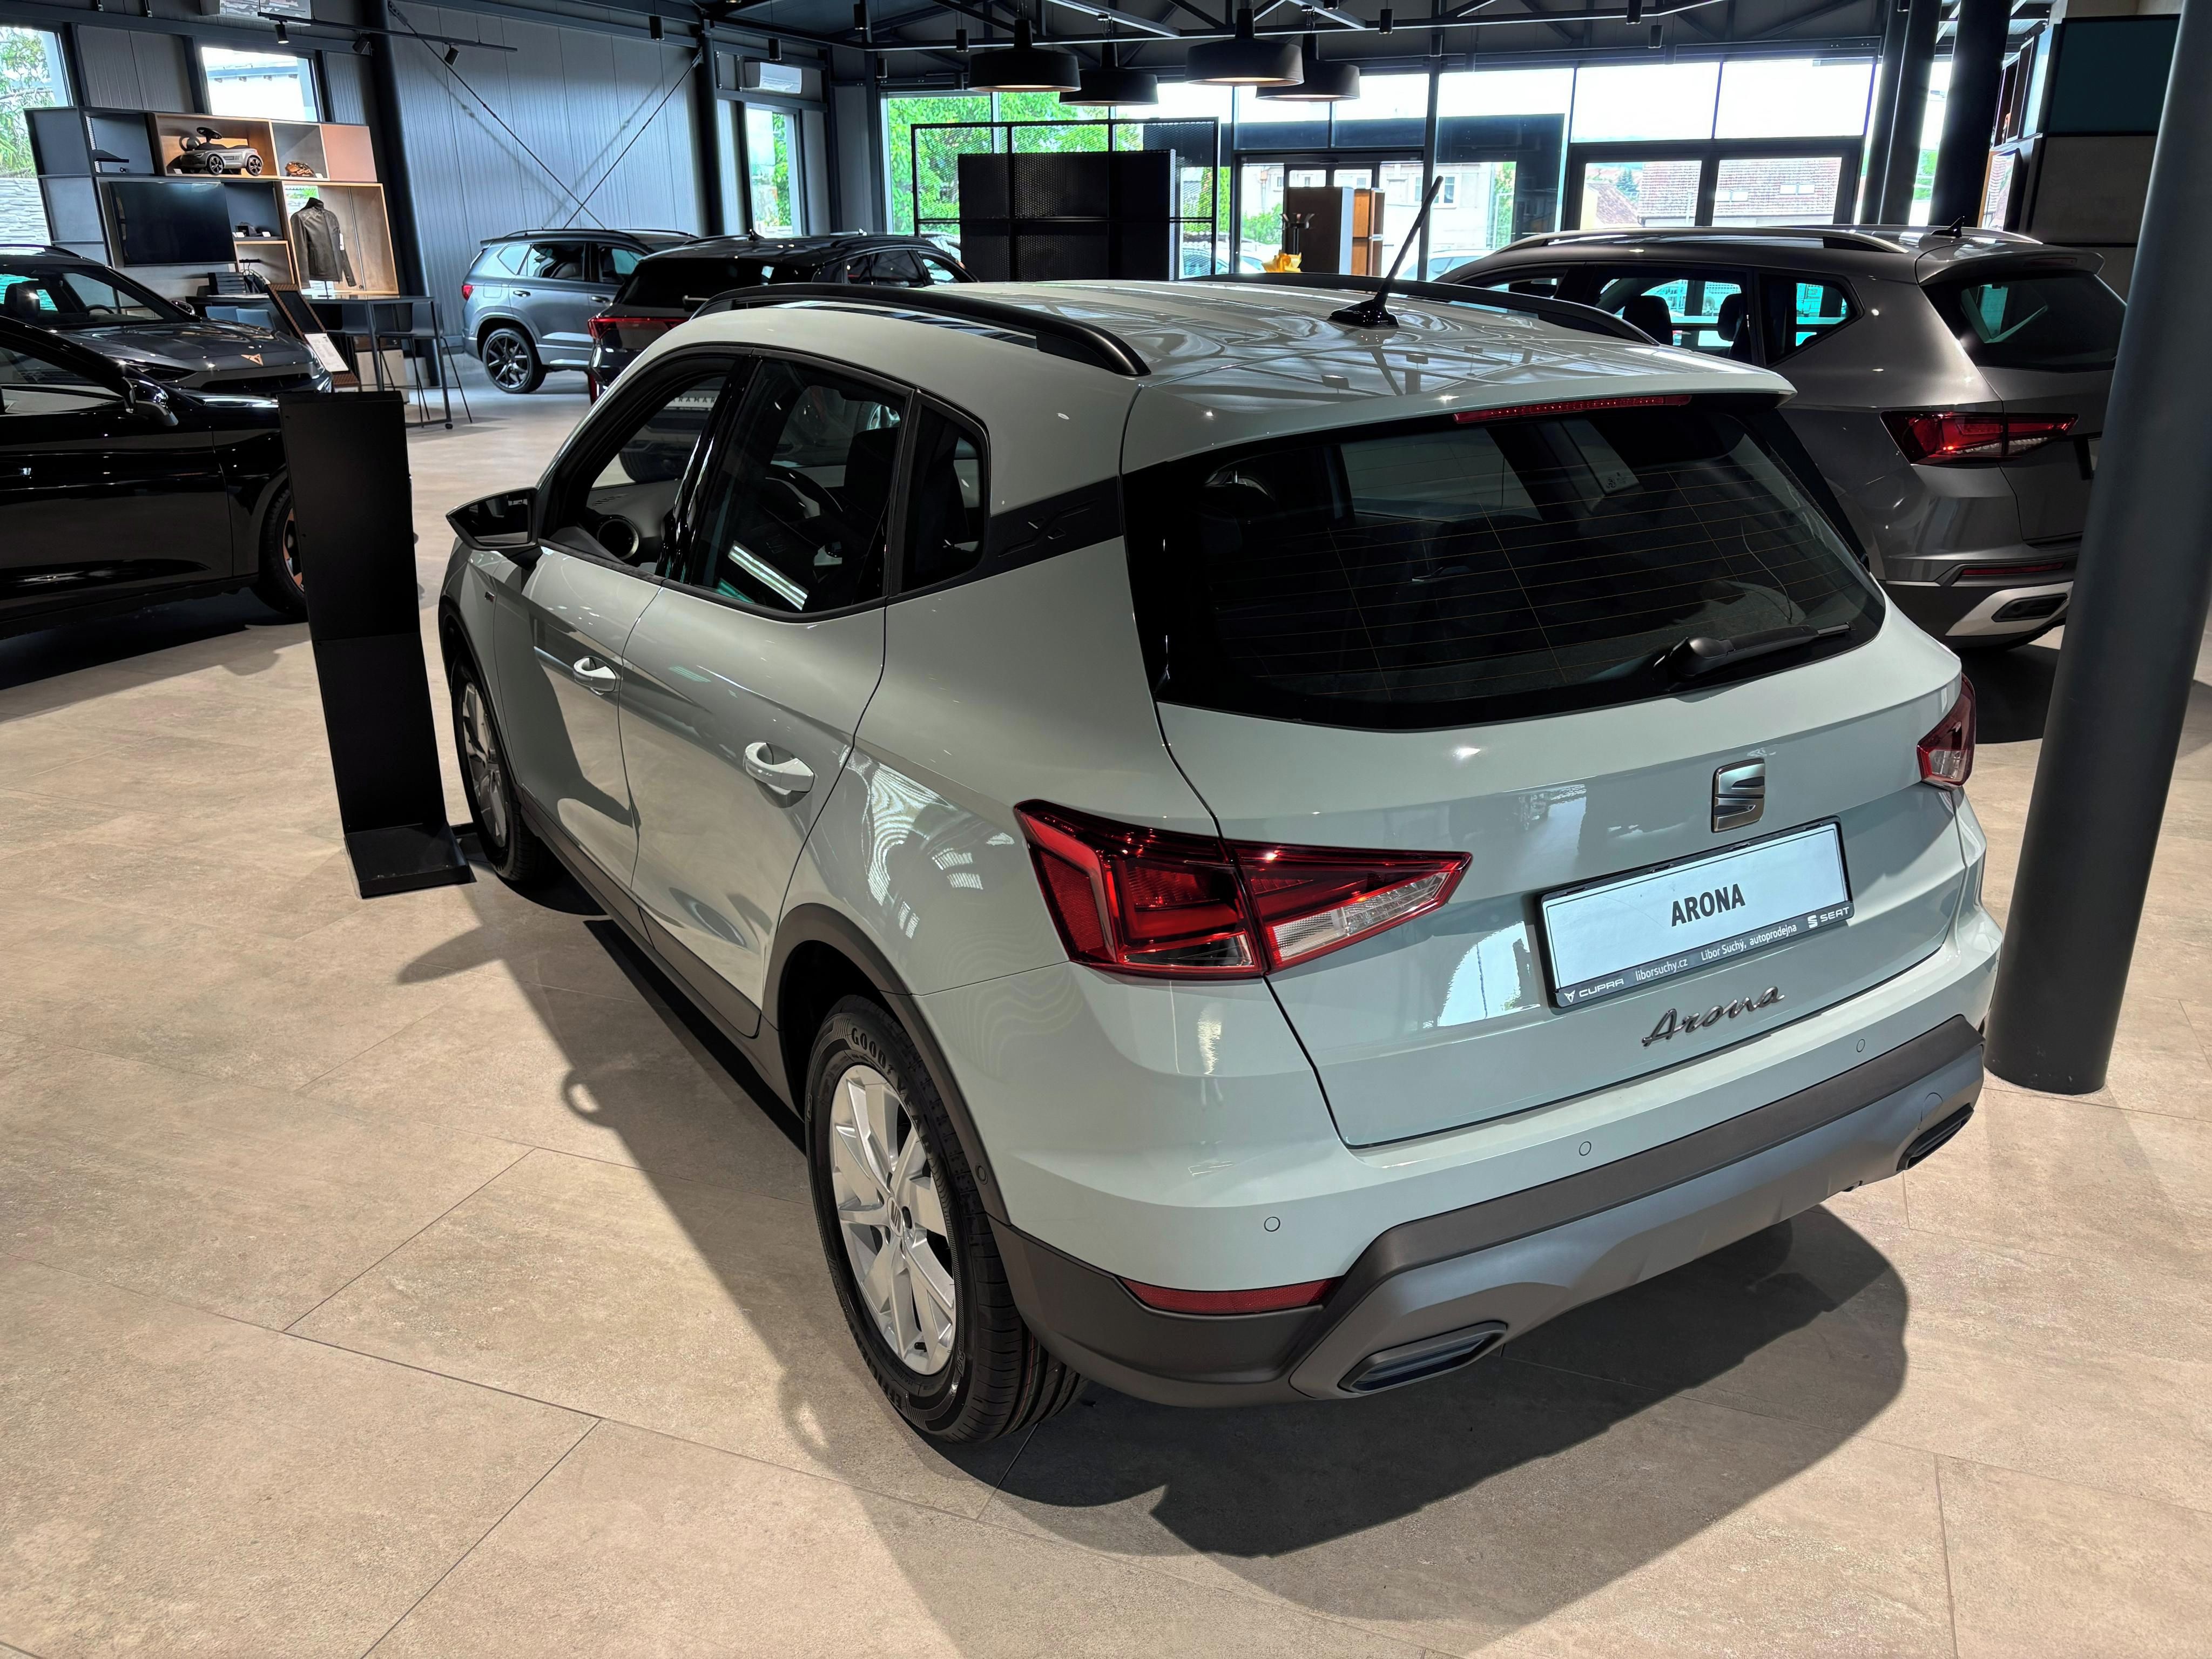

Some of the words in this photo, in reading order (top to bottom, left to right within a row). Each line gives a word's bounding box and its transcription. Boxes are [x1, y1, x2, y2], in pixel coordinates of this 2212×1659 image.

[1671, 884, 1745, 927] ARONA
[1820, 907, 1850, 922] SEAT
[1701, 948, 1720, 961] Libor
[1722, 940, 1747, 954] Suchý,
[1749, 924, 1797, 946] autoprodejna
[1635, 959, 1688, 981] liborsuchy.cz
[1579, 978, 1624, 997] CUPRA
[1642, 986, 1785, 1047] Arona
